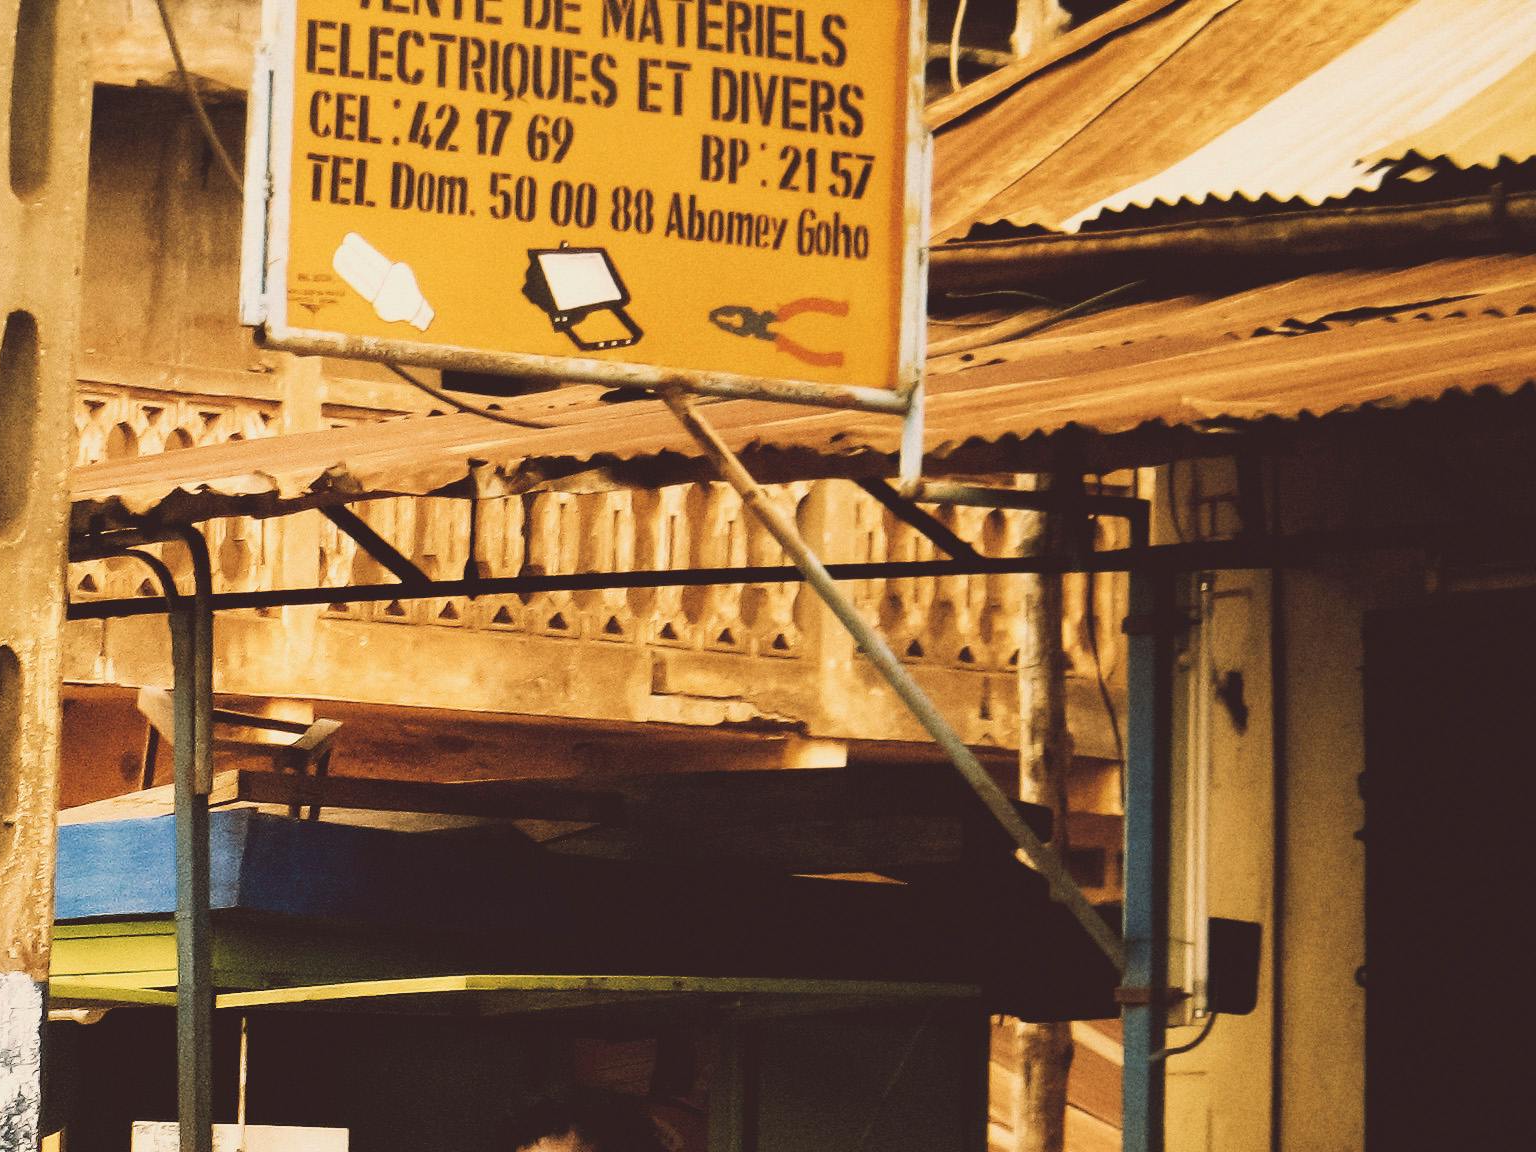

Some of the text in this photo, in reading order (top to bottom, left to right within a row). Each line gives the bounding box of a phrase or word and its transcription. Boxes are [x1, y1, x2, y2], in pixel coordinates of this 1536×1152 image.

[602, 0, 847, 68] MATERIELS
[305, 19, 865, 138] ELECTRIQUES ET DIVERS
[407, 100, 461, 152] 42
[475, 107, 513, 156] 17
[526, 113, 575, 164] 69
[306, 151, 870, 260] TEL Dom. 50 00 88 Abomey Goho
